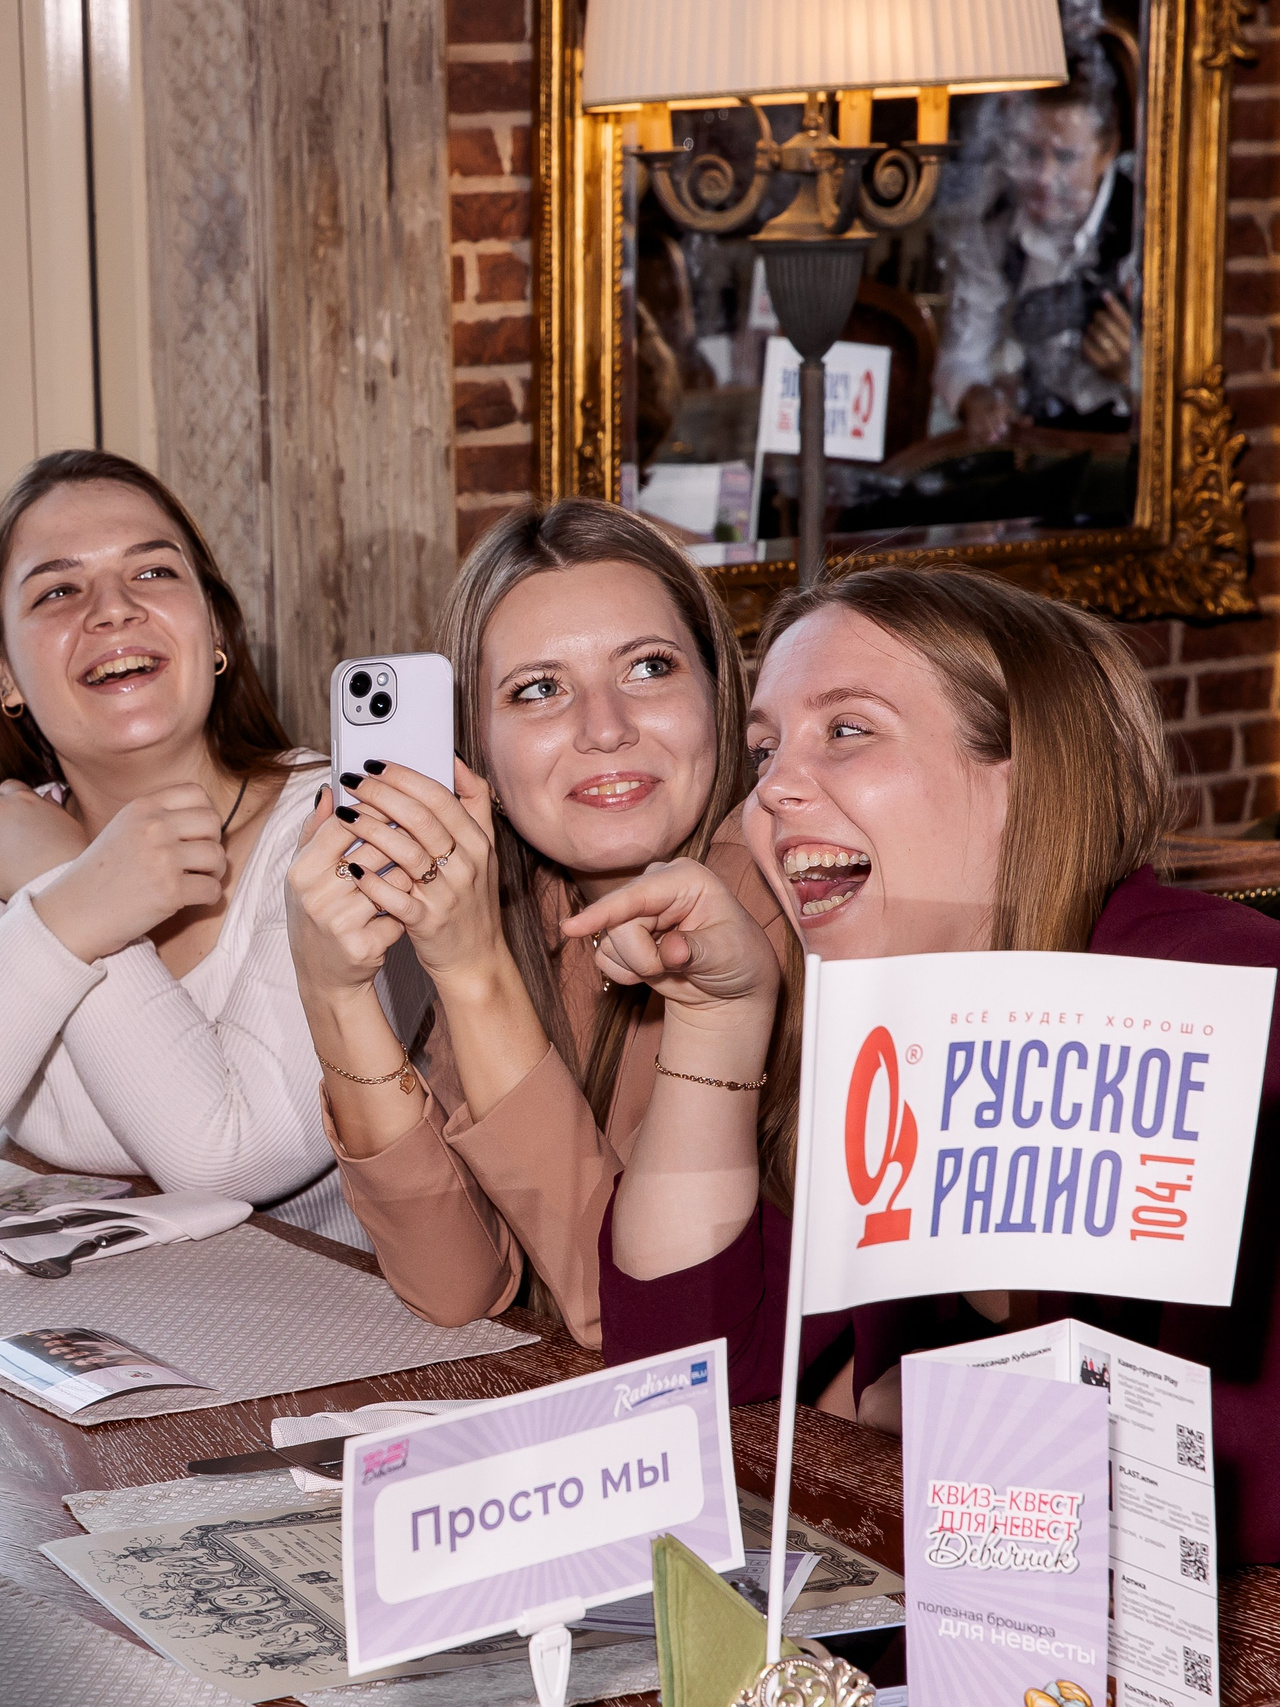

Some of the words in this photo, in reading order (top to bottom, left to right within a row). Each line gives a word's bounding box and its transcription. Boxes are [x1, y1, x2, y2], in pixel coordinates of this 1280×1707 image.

[950, 1010, 990, 1025] ВСЁ
[1008, 1010, 1085, 1025] БУДЕТ
[1105, 1014, 1215, 1036] ХОРОШО
[940, 1039, 1210, 1142] РУССКОЕ
[929, 1145, 1122, 1238] РАДИО
[1129, 1153, 1196, 1242] 104.1
[613, 1371, 690, 1418] Radisson
[410, 1475, 585, 1554] Просто
[600, 1451, 671, 1501] мы
[936, 1510, 987, 1534] ДЛЯ
[991, 1514, 1077, 1542] НЕВЕСТ
[917, 1600, 984, 1623] полезная
[987, 1611, 1057, 1638] брошюра
[938, 1617, 985, 1641] для
[991, 1627, 1096, 1665] невесты
